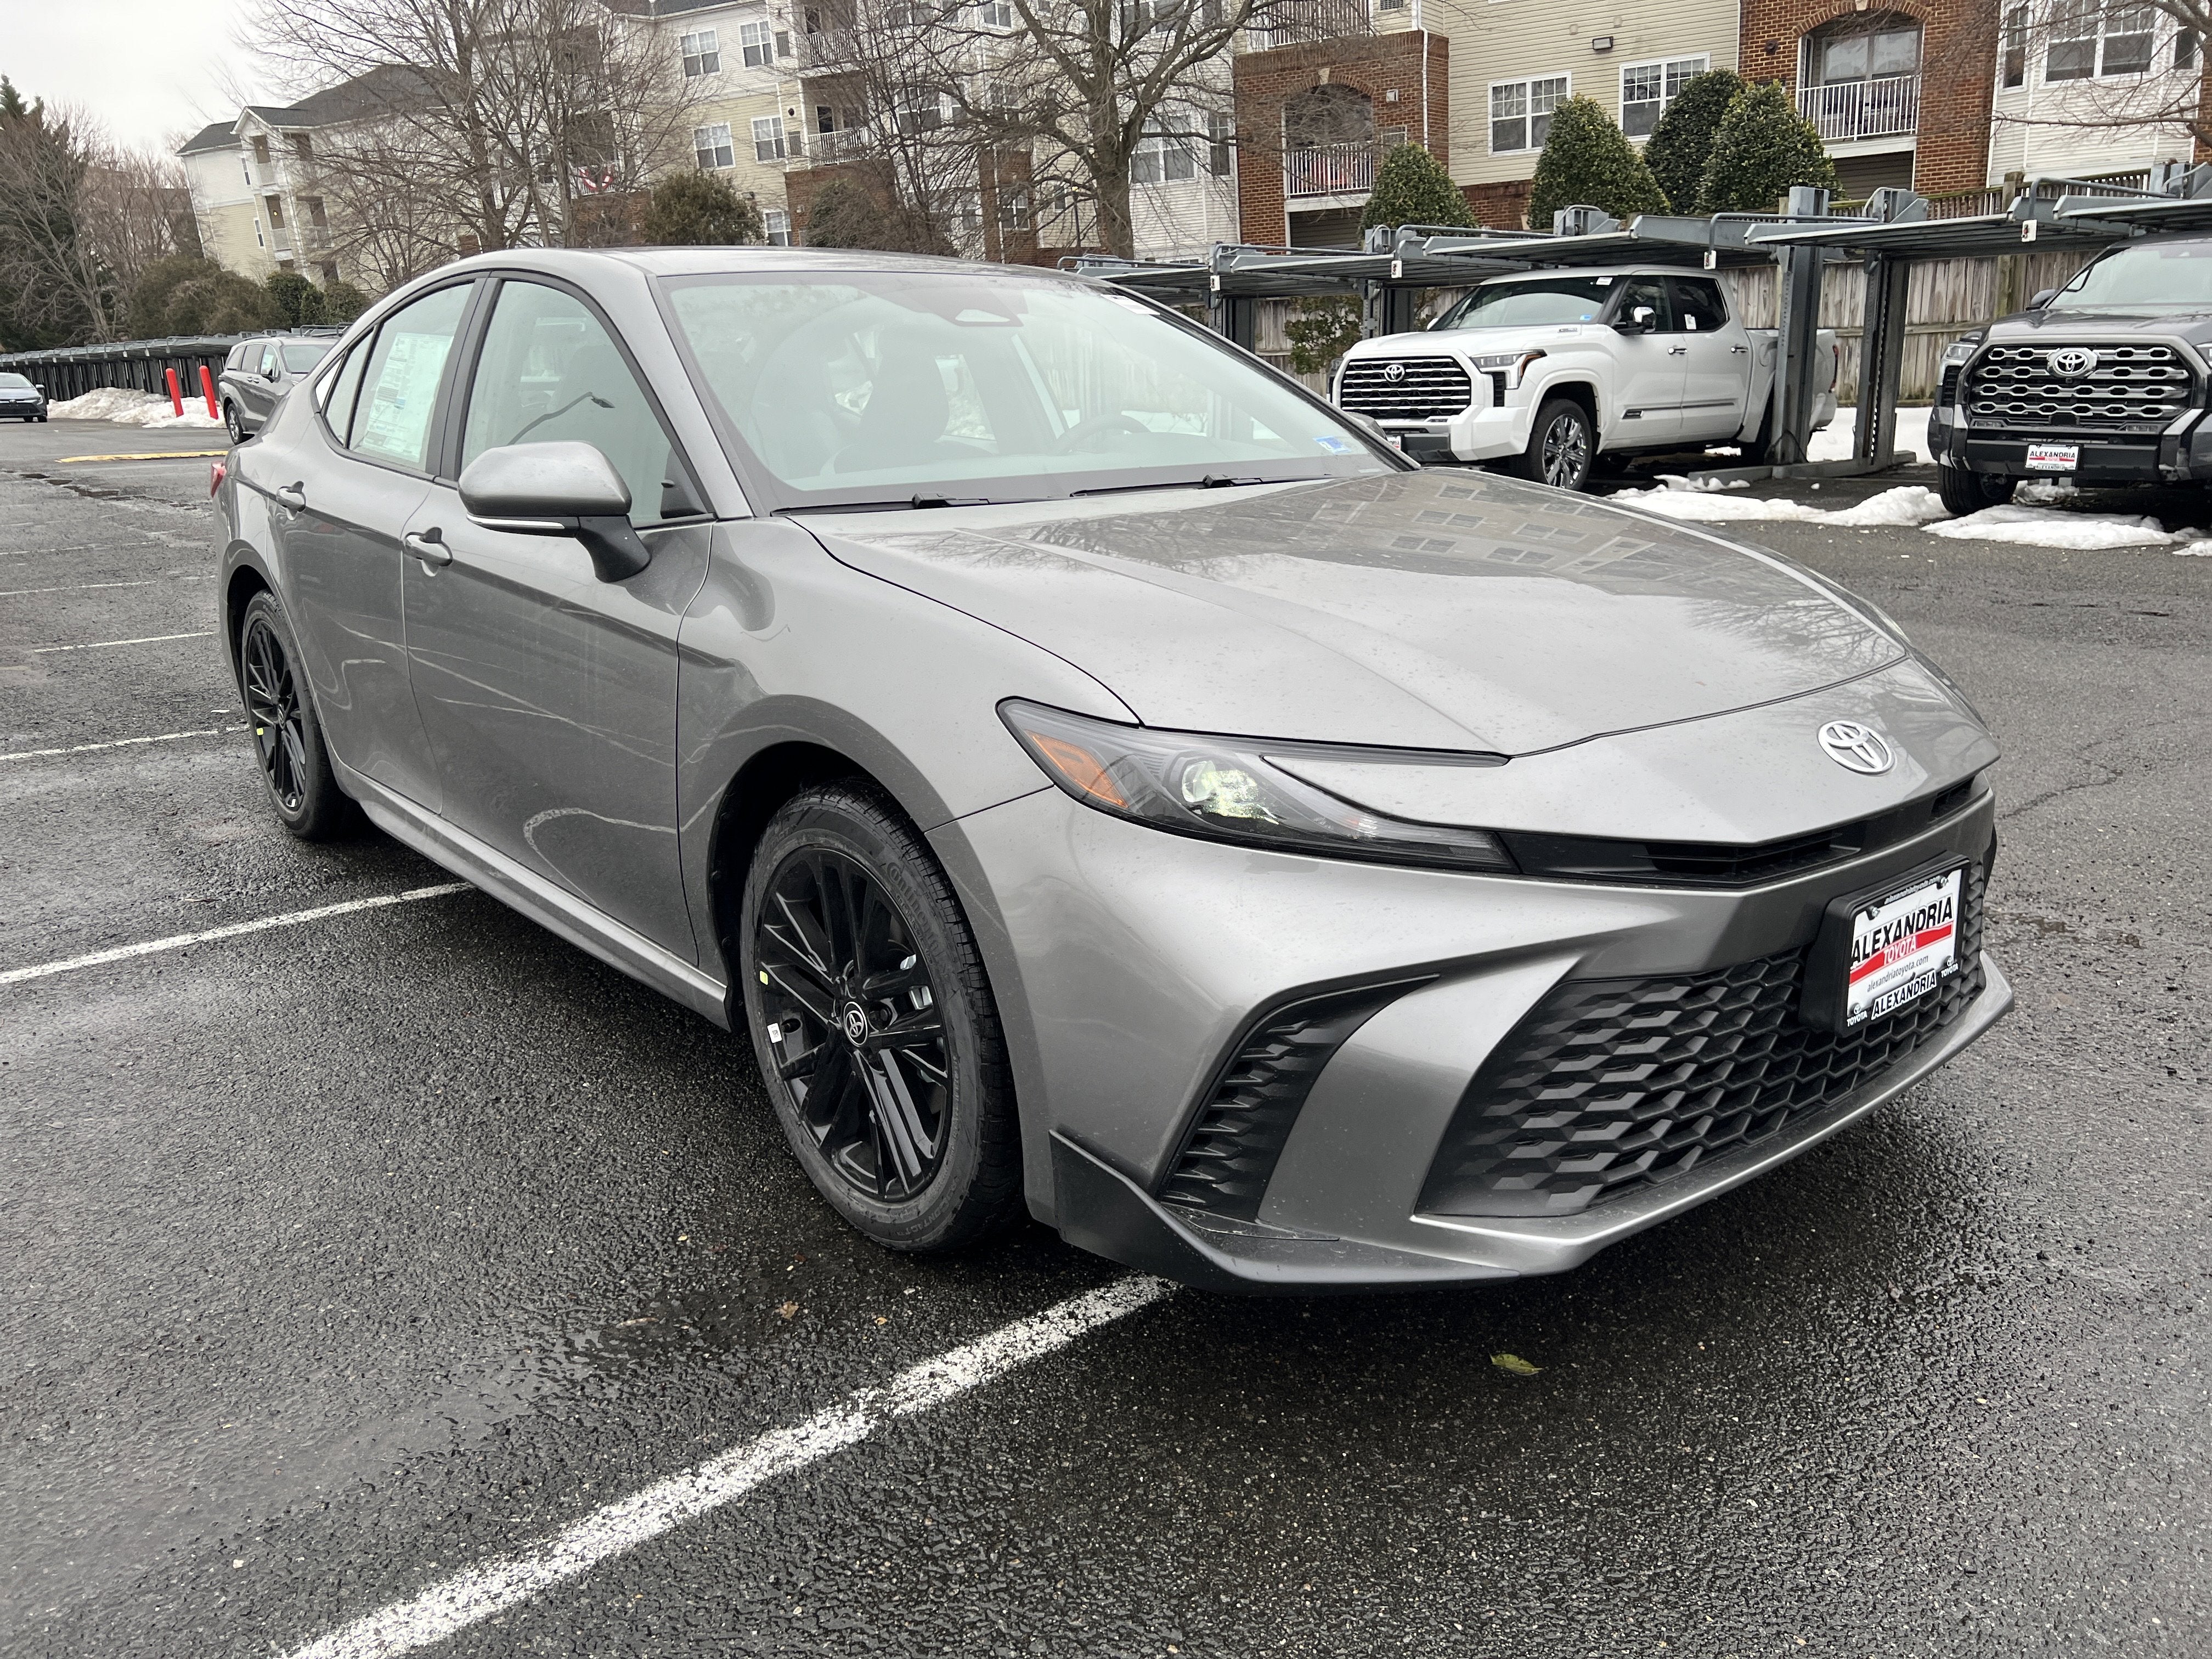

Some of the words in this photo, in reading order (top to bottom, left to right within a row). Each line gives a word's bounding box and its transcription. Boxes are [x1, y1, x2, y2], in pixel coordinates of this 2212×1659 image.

[1852, 896, 1953, 962] ALEXANDRIA
[1883, 934, 1916, 965] TOYOTA
[1867, 955, 1928, 992] alexandriatoyota.com
[1940, 963, 1959, 978] TOYOTA
[1872, 971, 1936, 1018] ALEXANDRIA
[1847, 1011, 1868, 1027] TOYOTA
